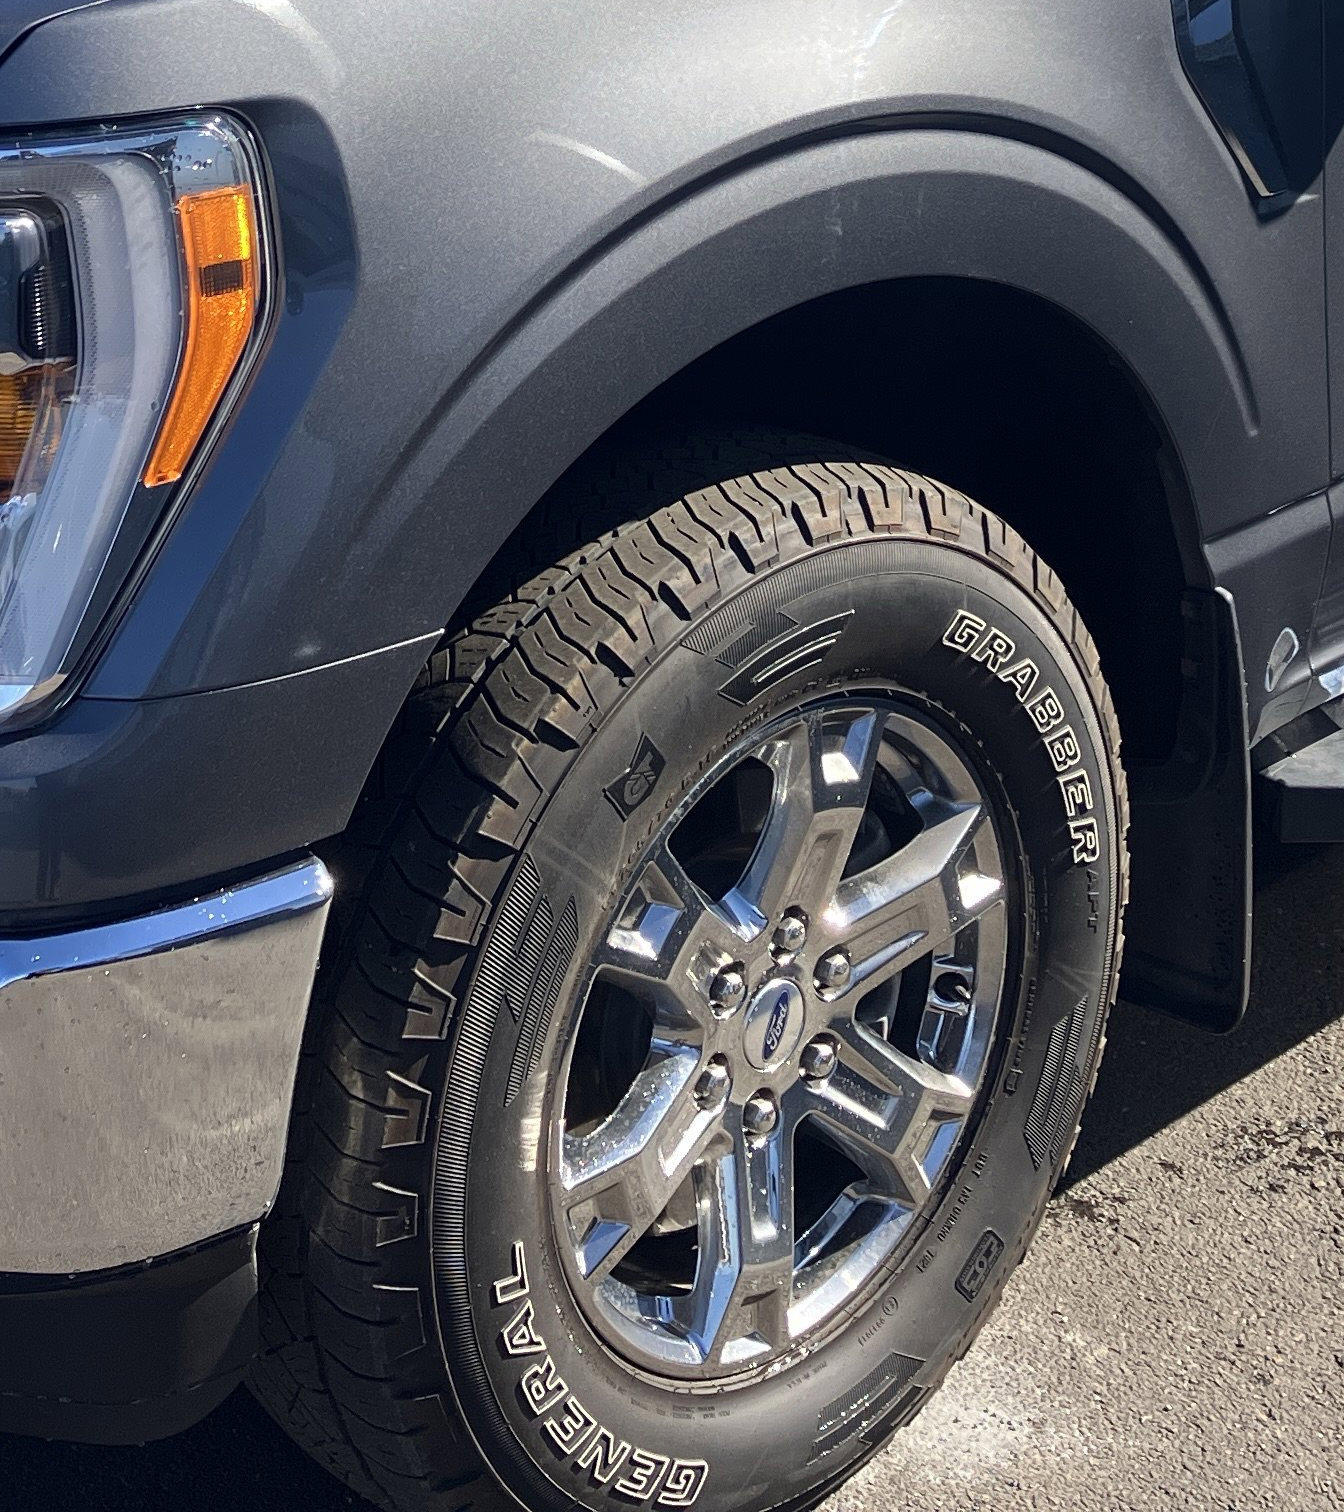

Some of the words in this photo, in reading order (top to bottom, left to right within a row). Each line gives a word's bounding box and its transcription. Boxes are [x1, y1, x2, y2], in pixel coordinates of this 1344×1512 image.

[941, 608, 1101, 865] GRABBER
[766, 1001, 789, 1051] Ford
[493, 1240, 710, 1507] GENERAL
